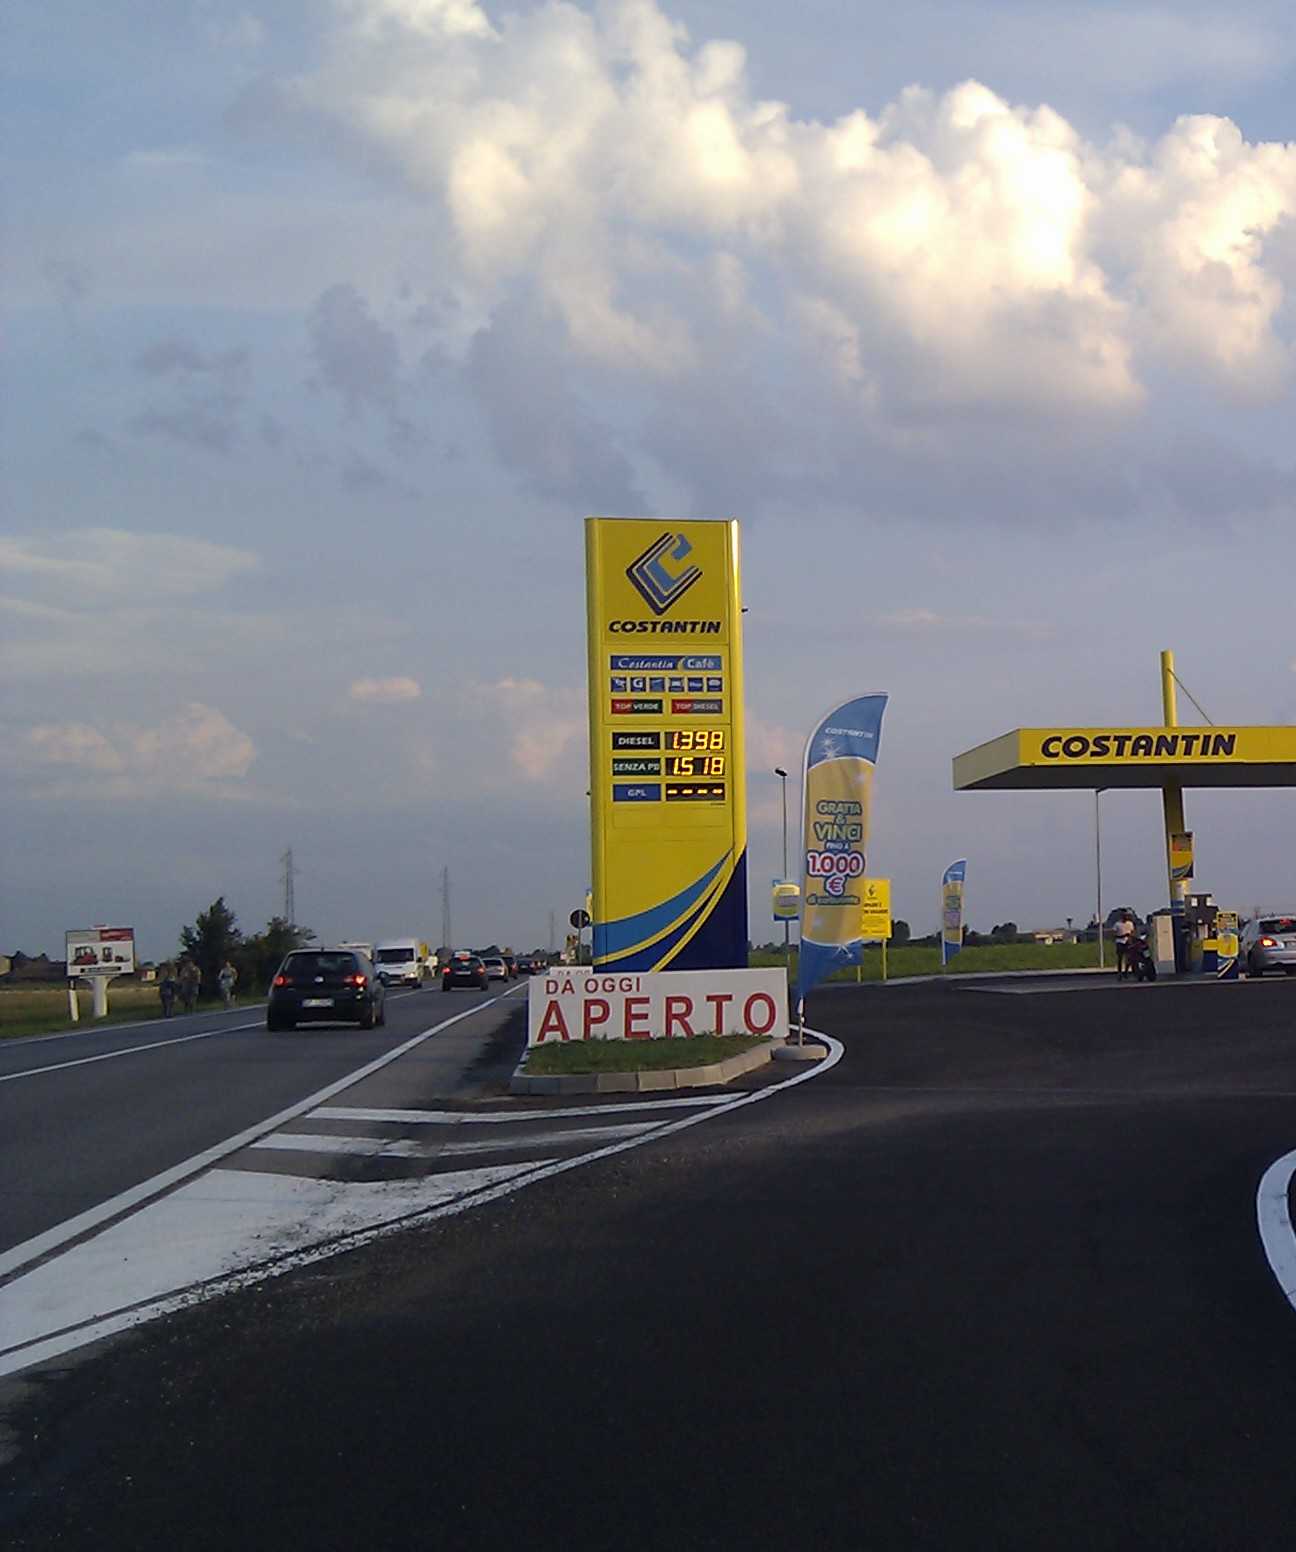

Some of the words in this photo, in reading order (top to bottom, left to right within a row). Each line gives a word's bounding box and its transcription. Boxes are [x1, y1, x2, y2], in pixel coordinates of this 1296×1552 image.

[608, 620, 721, 634] COSTANTIN
[633, 703, 659, 711] VERDE
[692, 703, 719, 711] DIESEL
[618, 737, 655, 746] DIESEL
[672, 731, 724, 750] 1.398
[1041, 734, 1236, 758] COSTANTIN
[613, 763, 646, 771] SENZA
[627, 789, 647, 797] GPL
[818, 802, 861, 814] GRATTA
[815, 823, 861, 840] VINCI
[809, 855, 860, 873] 1.000
[828, 877, 843, 892] €
[545, 978, 575, 995] DA
[584, 977, 640, 993] OGGI
[536, 993, 777, 1042] APERTO
